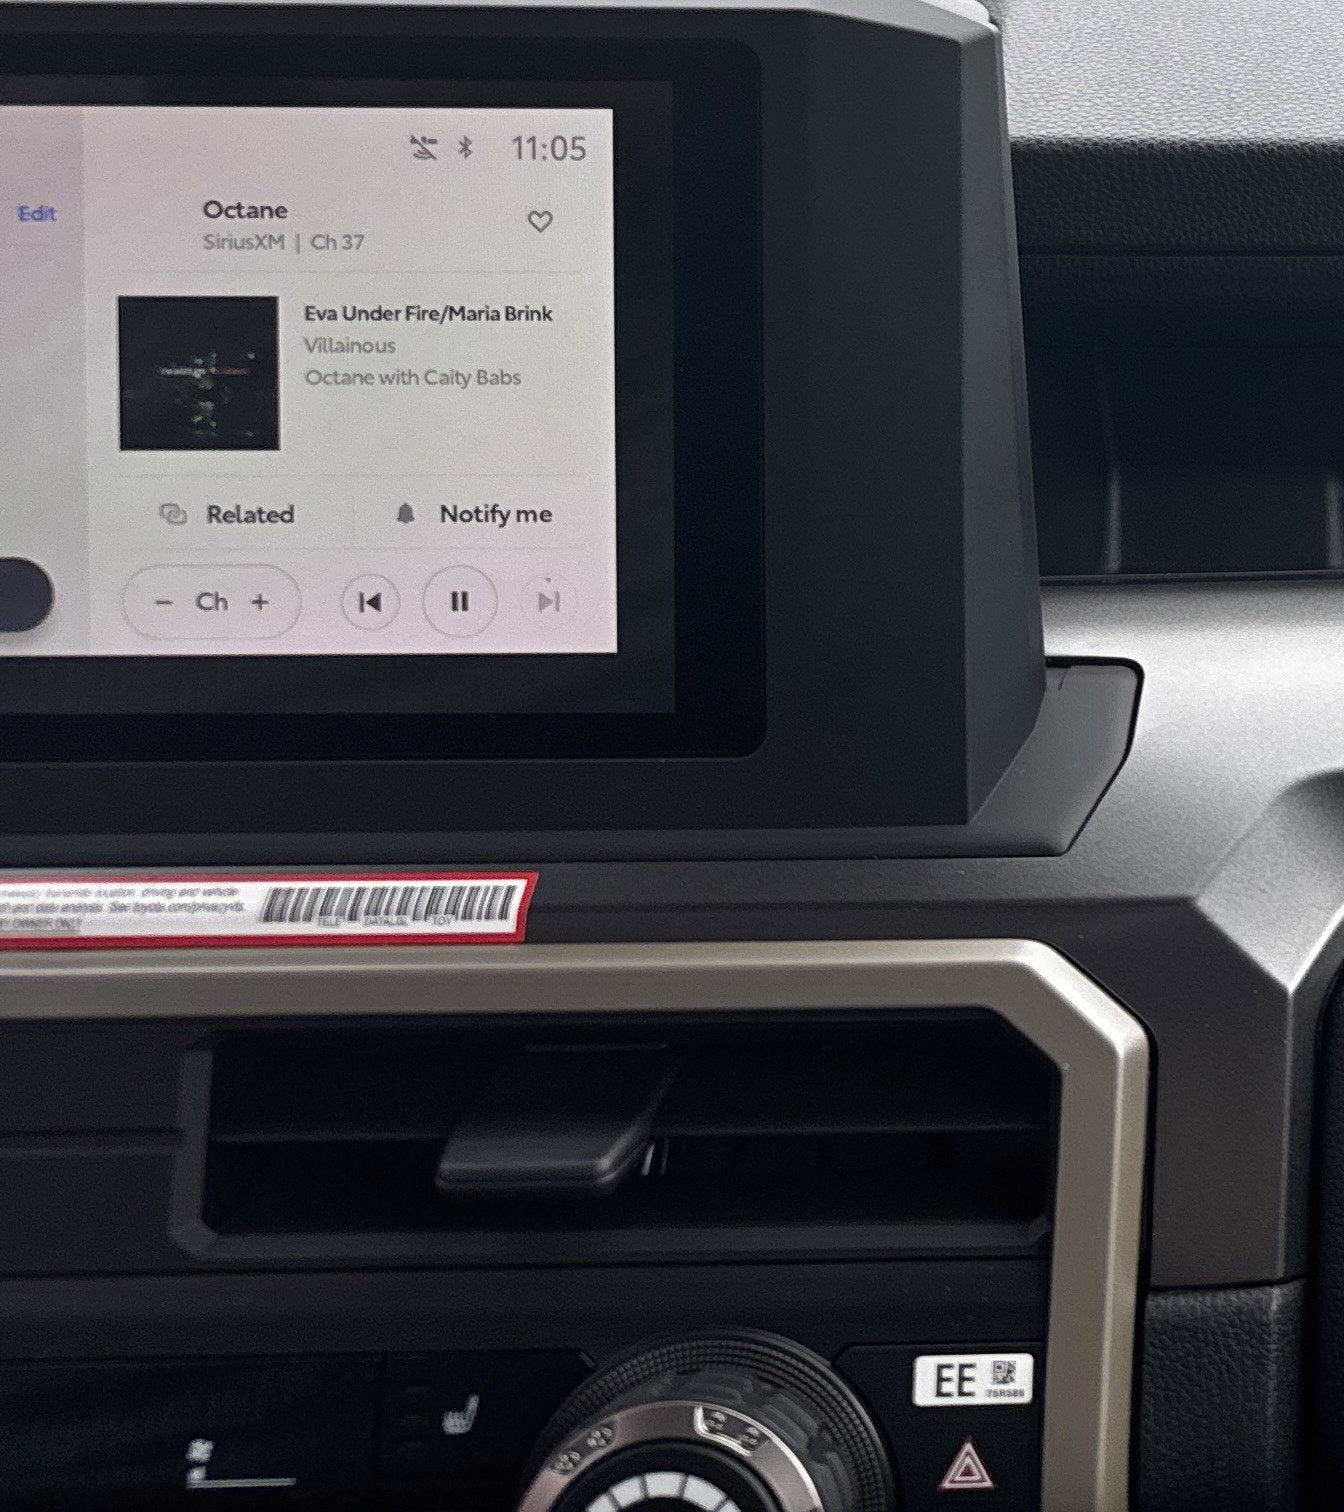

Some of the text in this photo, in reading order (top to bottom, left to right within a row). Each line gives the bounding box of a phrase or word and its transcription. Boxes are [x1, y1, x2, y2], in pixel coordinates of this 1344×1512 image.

[511, 134, 587, 163] 11:05
[17, 205, 57, 223] Edit
[203, 199, 289, 219] Octane
[203, 233, 365, 250] SiriusXM Ch 37
[304, 305, 553, 325] Eva Under Fire/Maria Brink
[304, 337, 396, 355] Villainous
[304, 368, 521, 390] Octane with Caity Babs
[206, 503, 295, 525] Related
[440, 503, 553, 528] Notify me
[195, 592, 228, 612] Ch
[935, 1362, 977, 1397] EE
